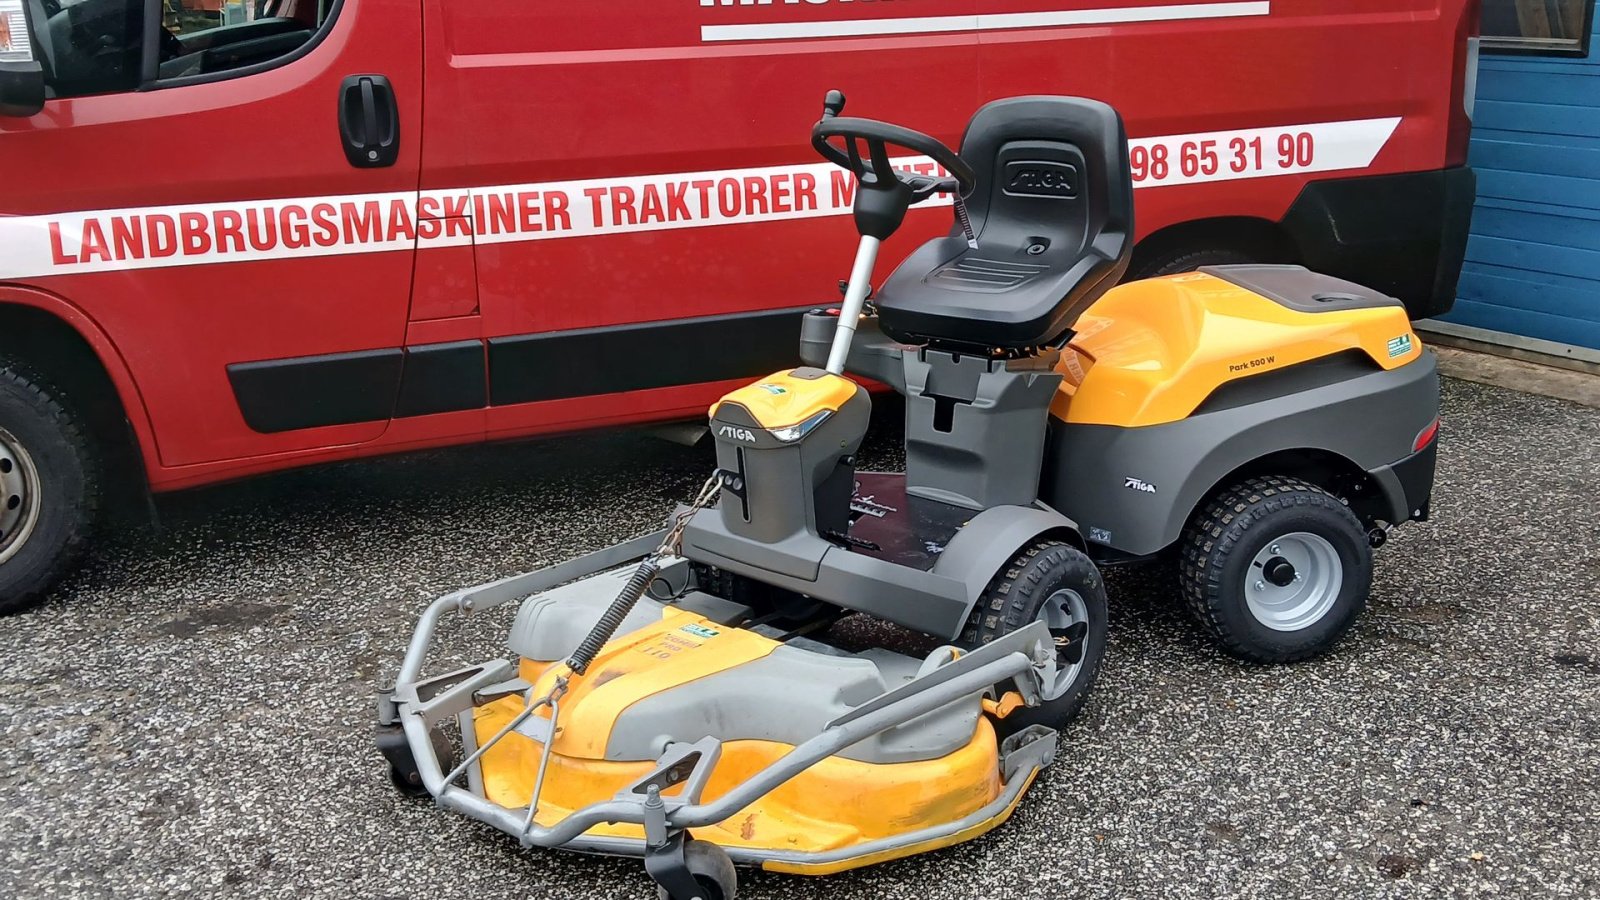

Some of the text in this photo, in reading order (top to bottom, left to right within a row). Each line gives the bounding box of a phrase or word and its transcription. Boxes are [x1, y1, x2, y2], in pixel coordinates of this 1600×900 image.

[48, 190, 571, 265] LANDBRUGSMASKINER
[583, 173, 818, 228] TRAKTORER
[1131, 144, 1169, 182] 98
[1180, 141, 1218, 177] 65
[1229, 136, 1263, 173] 31
[1277, 132, 1314, 169] 90
[1229, 356, 1275, 372] Park 500 W
[719, 425, 756, 443] STIGA
[1125, 476, 1156, 493] STIGA
